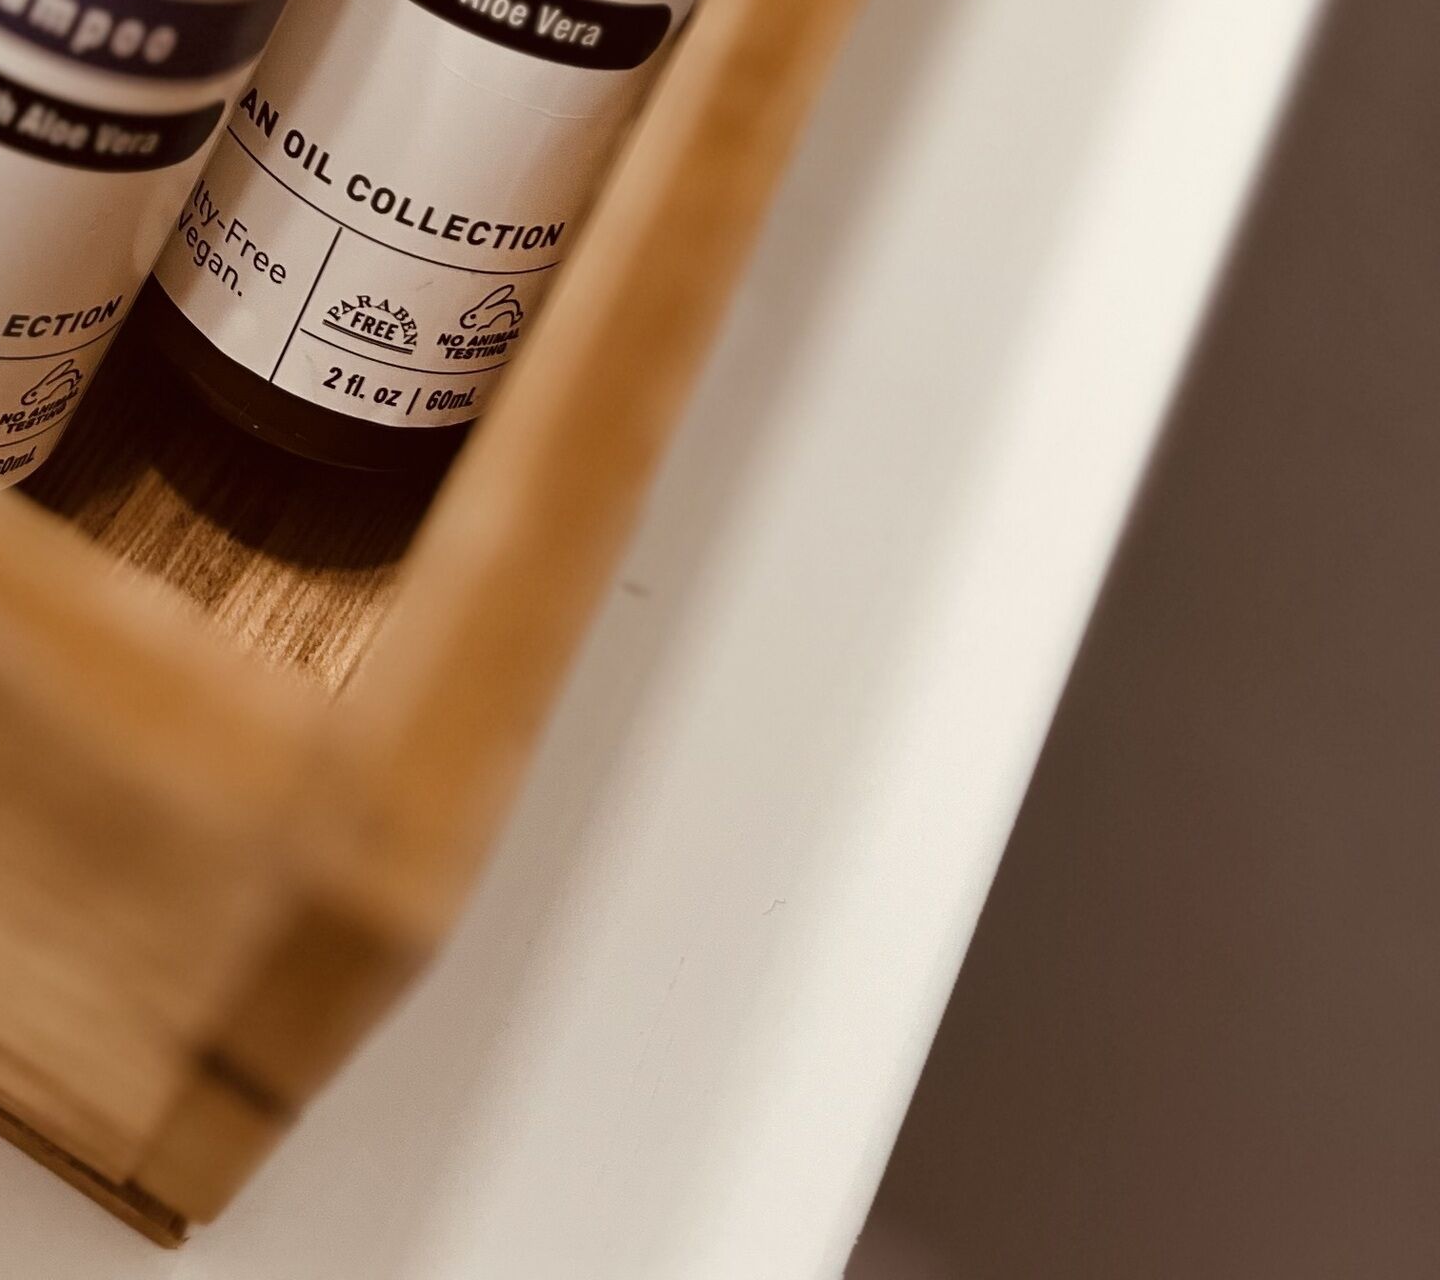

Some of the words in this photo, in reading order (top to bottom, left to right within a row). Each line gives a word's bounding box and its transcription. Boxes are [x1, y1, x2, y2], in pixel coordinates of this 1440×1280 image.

[536, 4, 603, 49] Vera
[17, 102, 86, 151] Aloe
[88, 122, 159, 157] Vera
[283, 130, 332, 185] OIL
[346, 174, 565, 250] COLLECTION
[194, 180, 288, 285] lty-Free
[327, 295, 418, 349] PARABEN
[350, 311, 399, 342] FREE
[437, 332, 465, 348] NO
[468, 327, 521, 347] ANIMAL
[444, 342, 508, 361] TESTING
[323, 367, 343, 390] 2
[372, 388, 404, 408] oz
[425, 387, 477, 412] 60mL
[0, 412, 24, 429] NO
